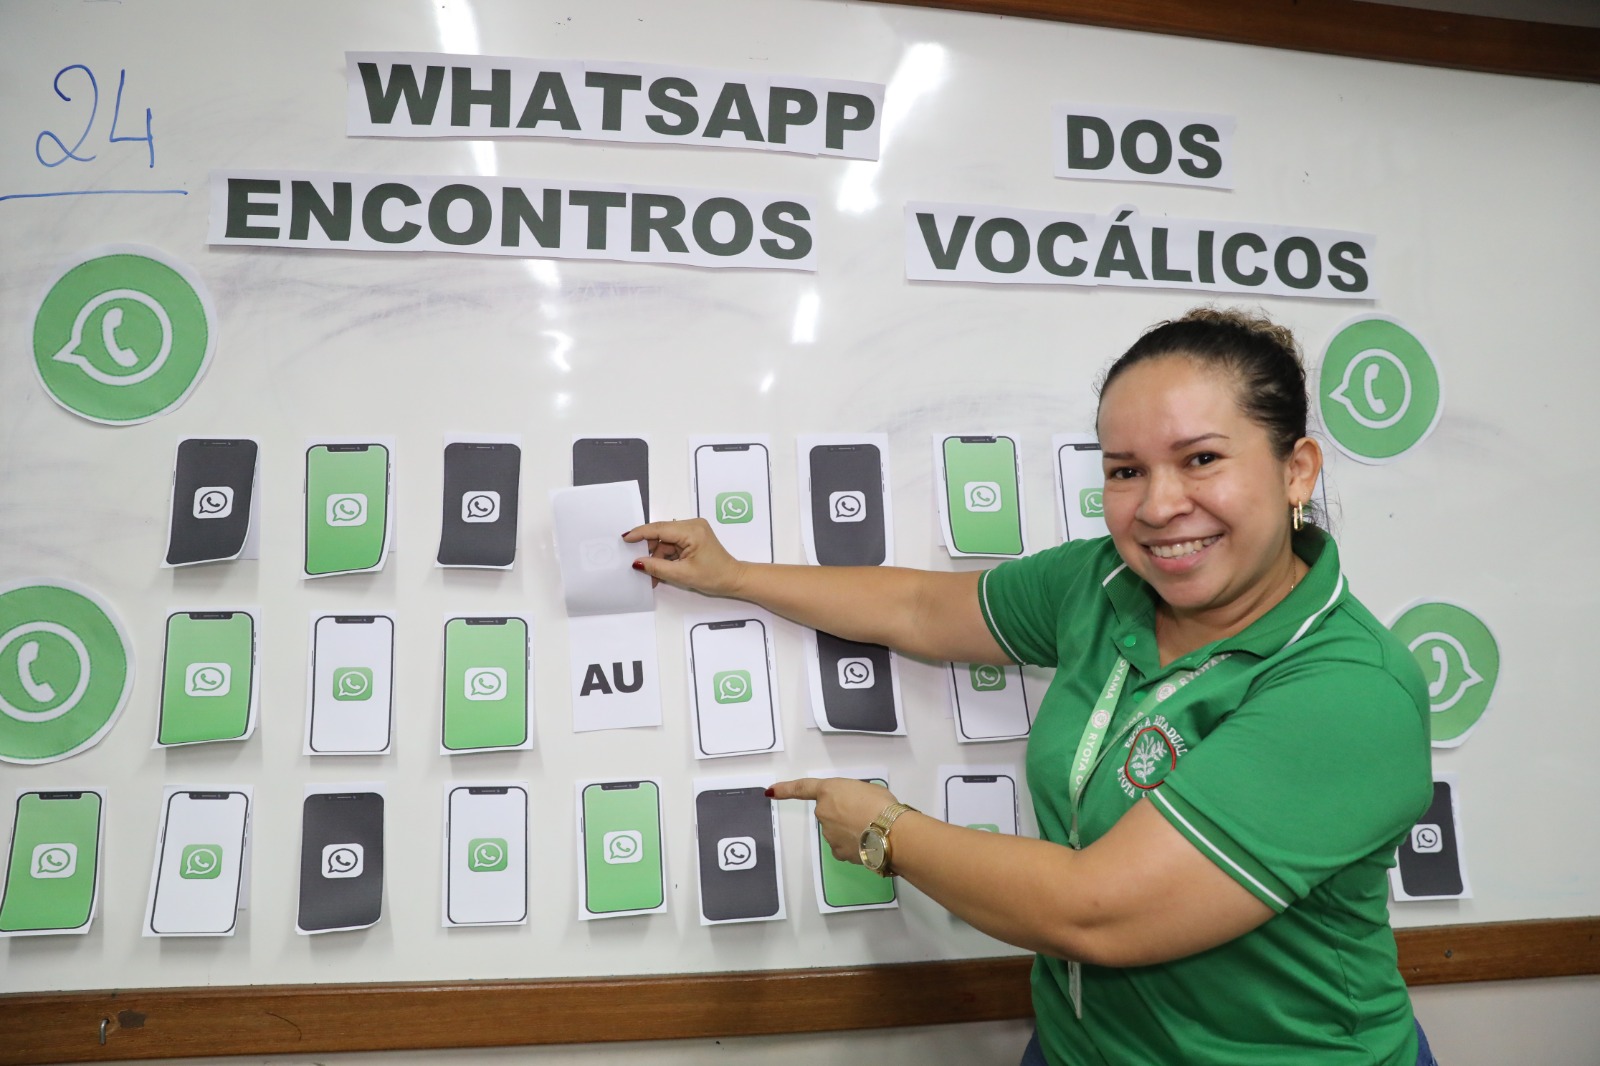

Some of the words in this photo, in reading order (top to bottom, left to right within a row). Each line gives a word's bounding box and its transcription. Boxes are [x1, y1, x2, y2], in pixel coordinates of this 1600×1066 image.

[36, 64, 154, 168] 24
[357, 62, 875, 149] WHATSAPP
[1067, 115, 1222, 178] DOS
[226, 178, 813, 260] ENCONTROS
[916, 210, 1368, 292] VOCÁLICOS
[580, 661, 643, 696] AU
[1078, 732, 1098, 771] RYOTA
